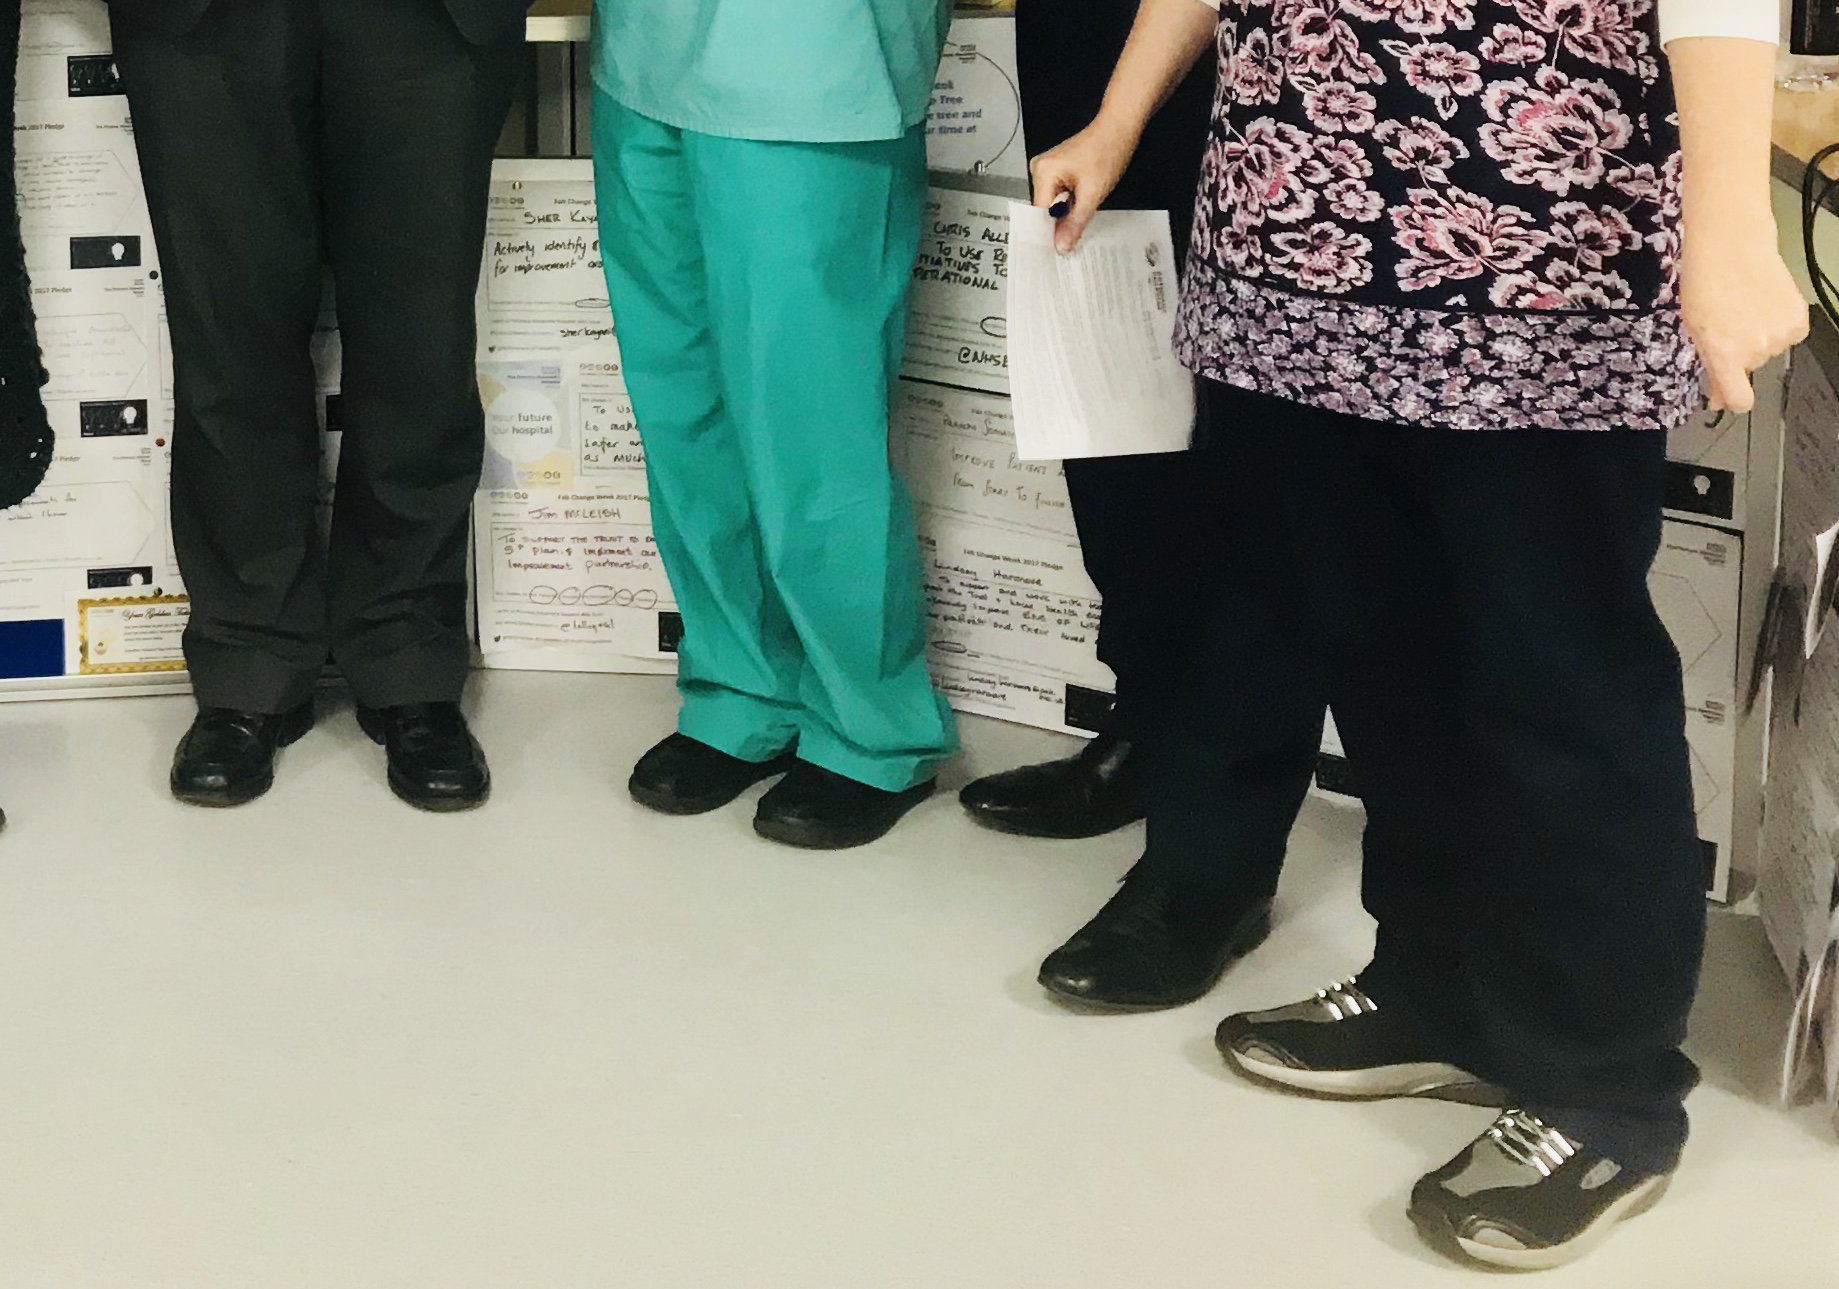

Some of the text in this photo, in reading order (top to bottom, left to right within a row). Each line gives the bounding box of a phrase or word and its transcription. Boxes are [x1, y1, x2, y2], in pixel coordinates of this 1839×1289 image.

[523, 211, 561, 225] SHER
[494, 235, 587, 261] Actively identify
[494, 258, 509, 278] for
[518, 412, 553, 422] future
[511, 425, 553, 436] hospital
